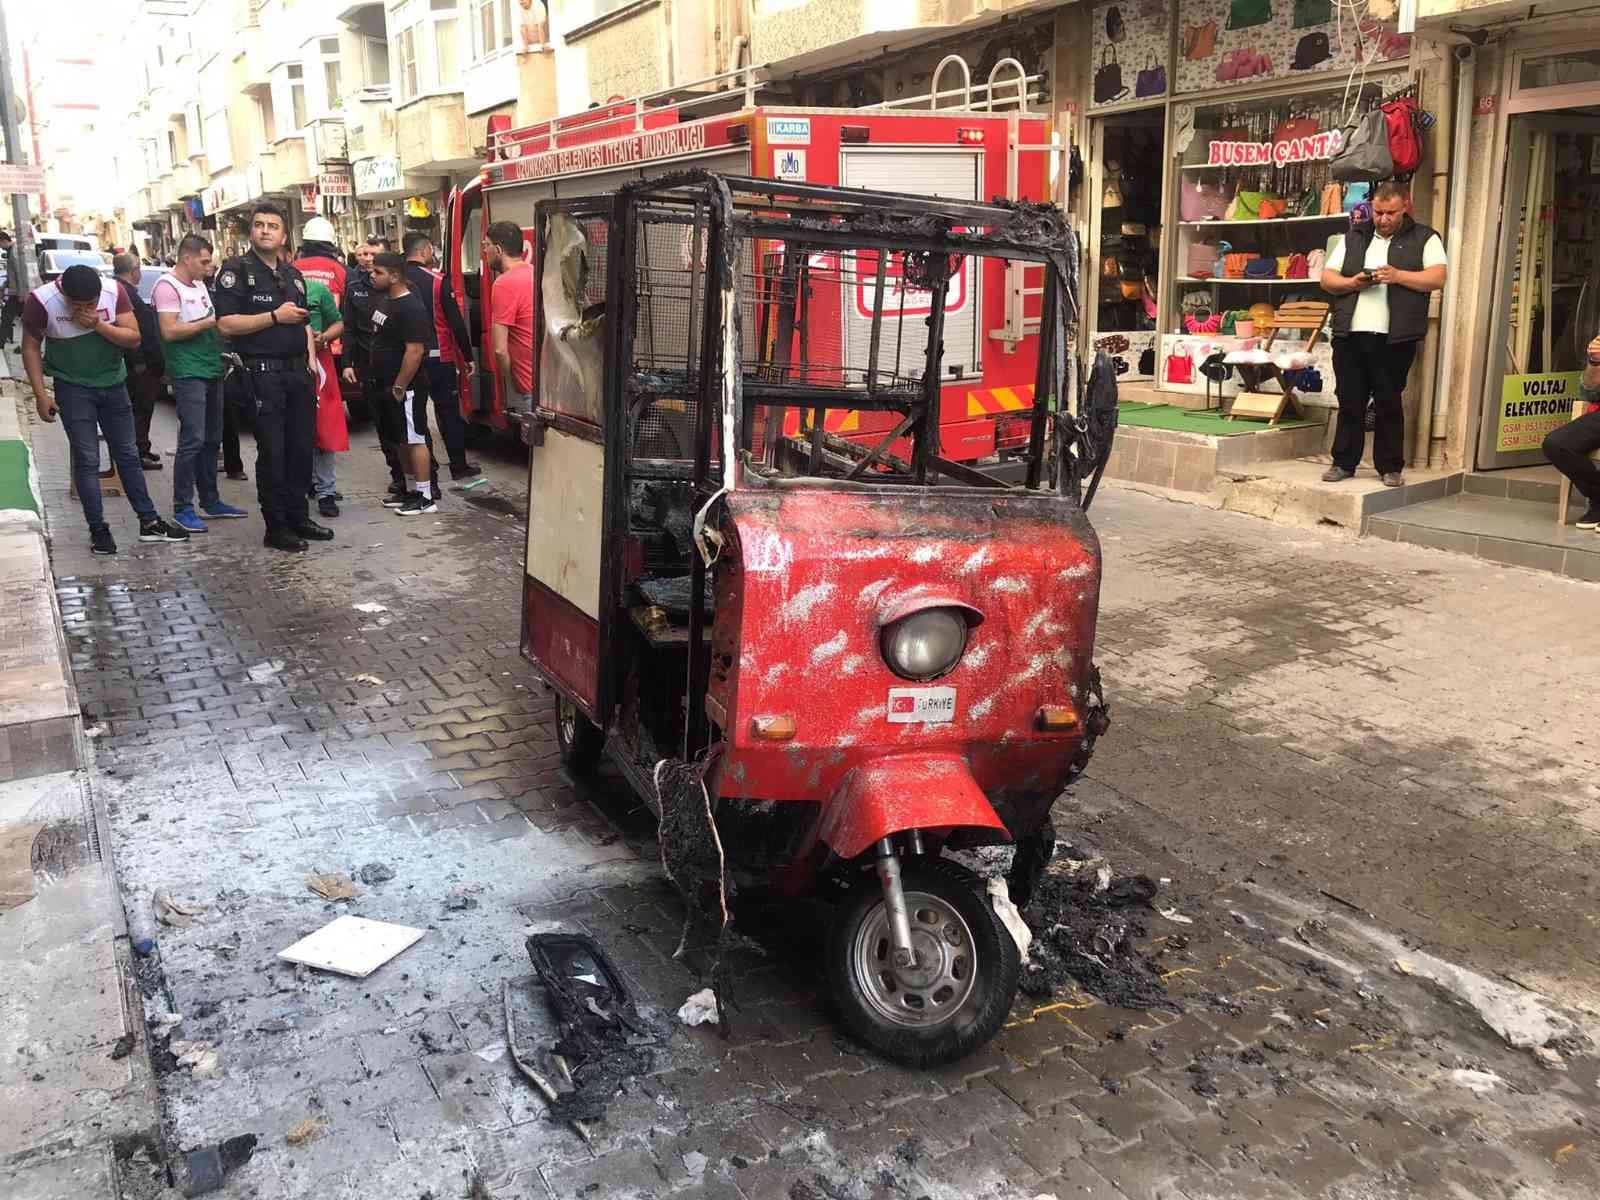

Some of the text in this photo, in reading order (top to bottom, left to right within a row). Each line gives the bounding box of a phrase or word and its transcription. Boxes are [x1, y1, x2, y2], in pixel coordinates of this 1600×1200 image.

[774, 121, 809, 135] KARBA
[1209, 129, 1342, 167] BUSEM ÇANTA
[1523, 379, 1567, 396] VOLTAJ
